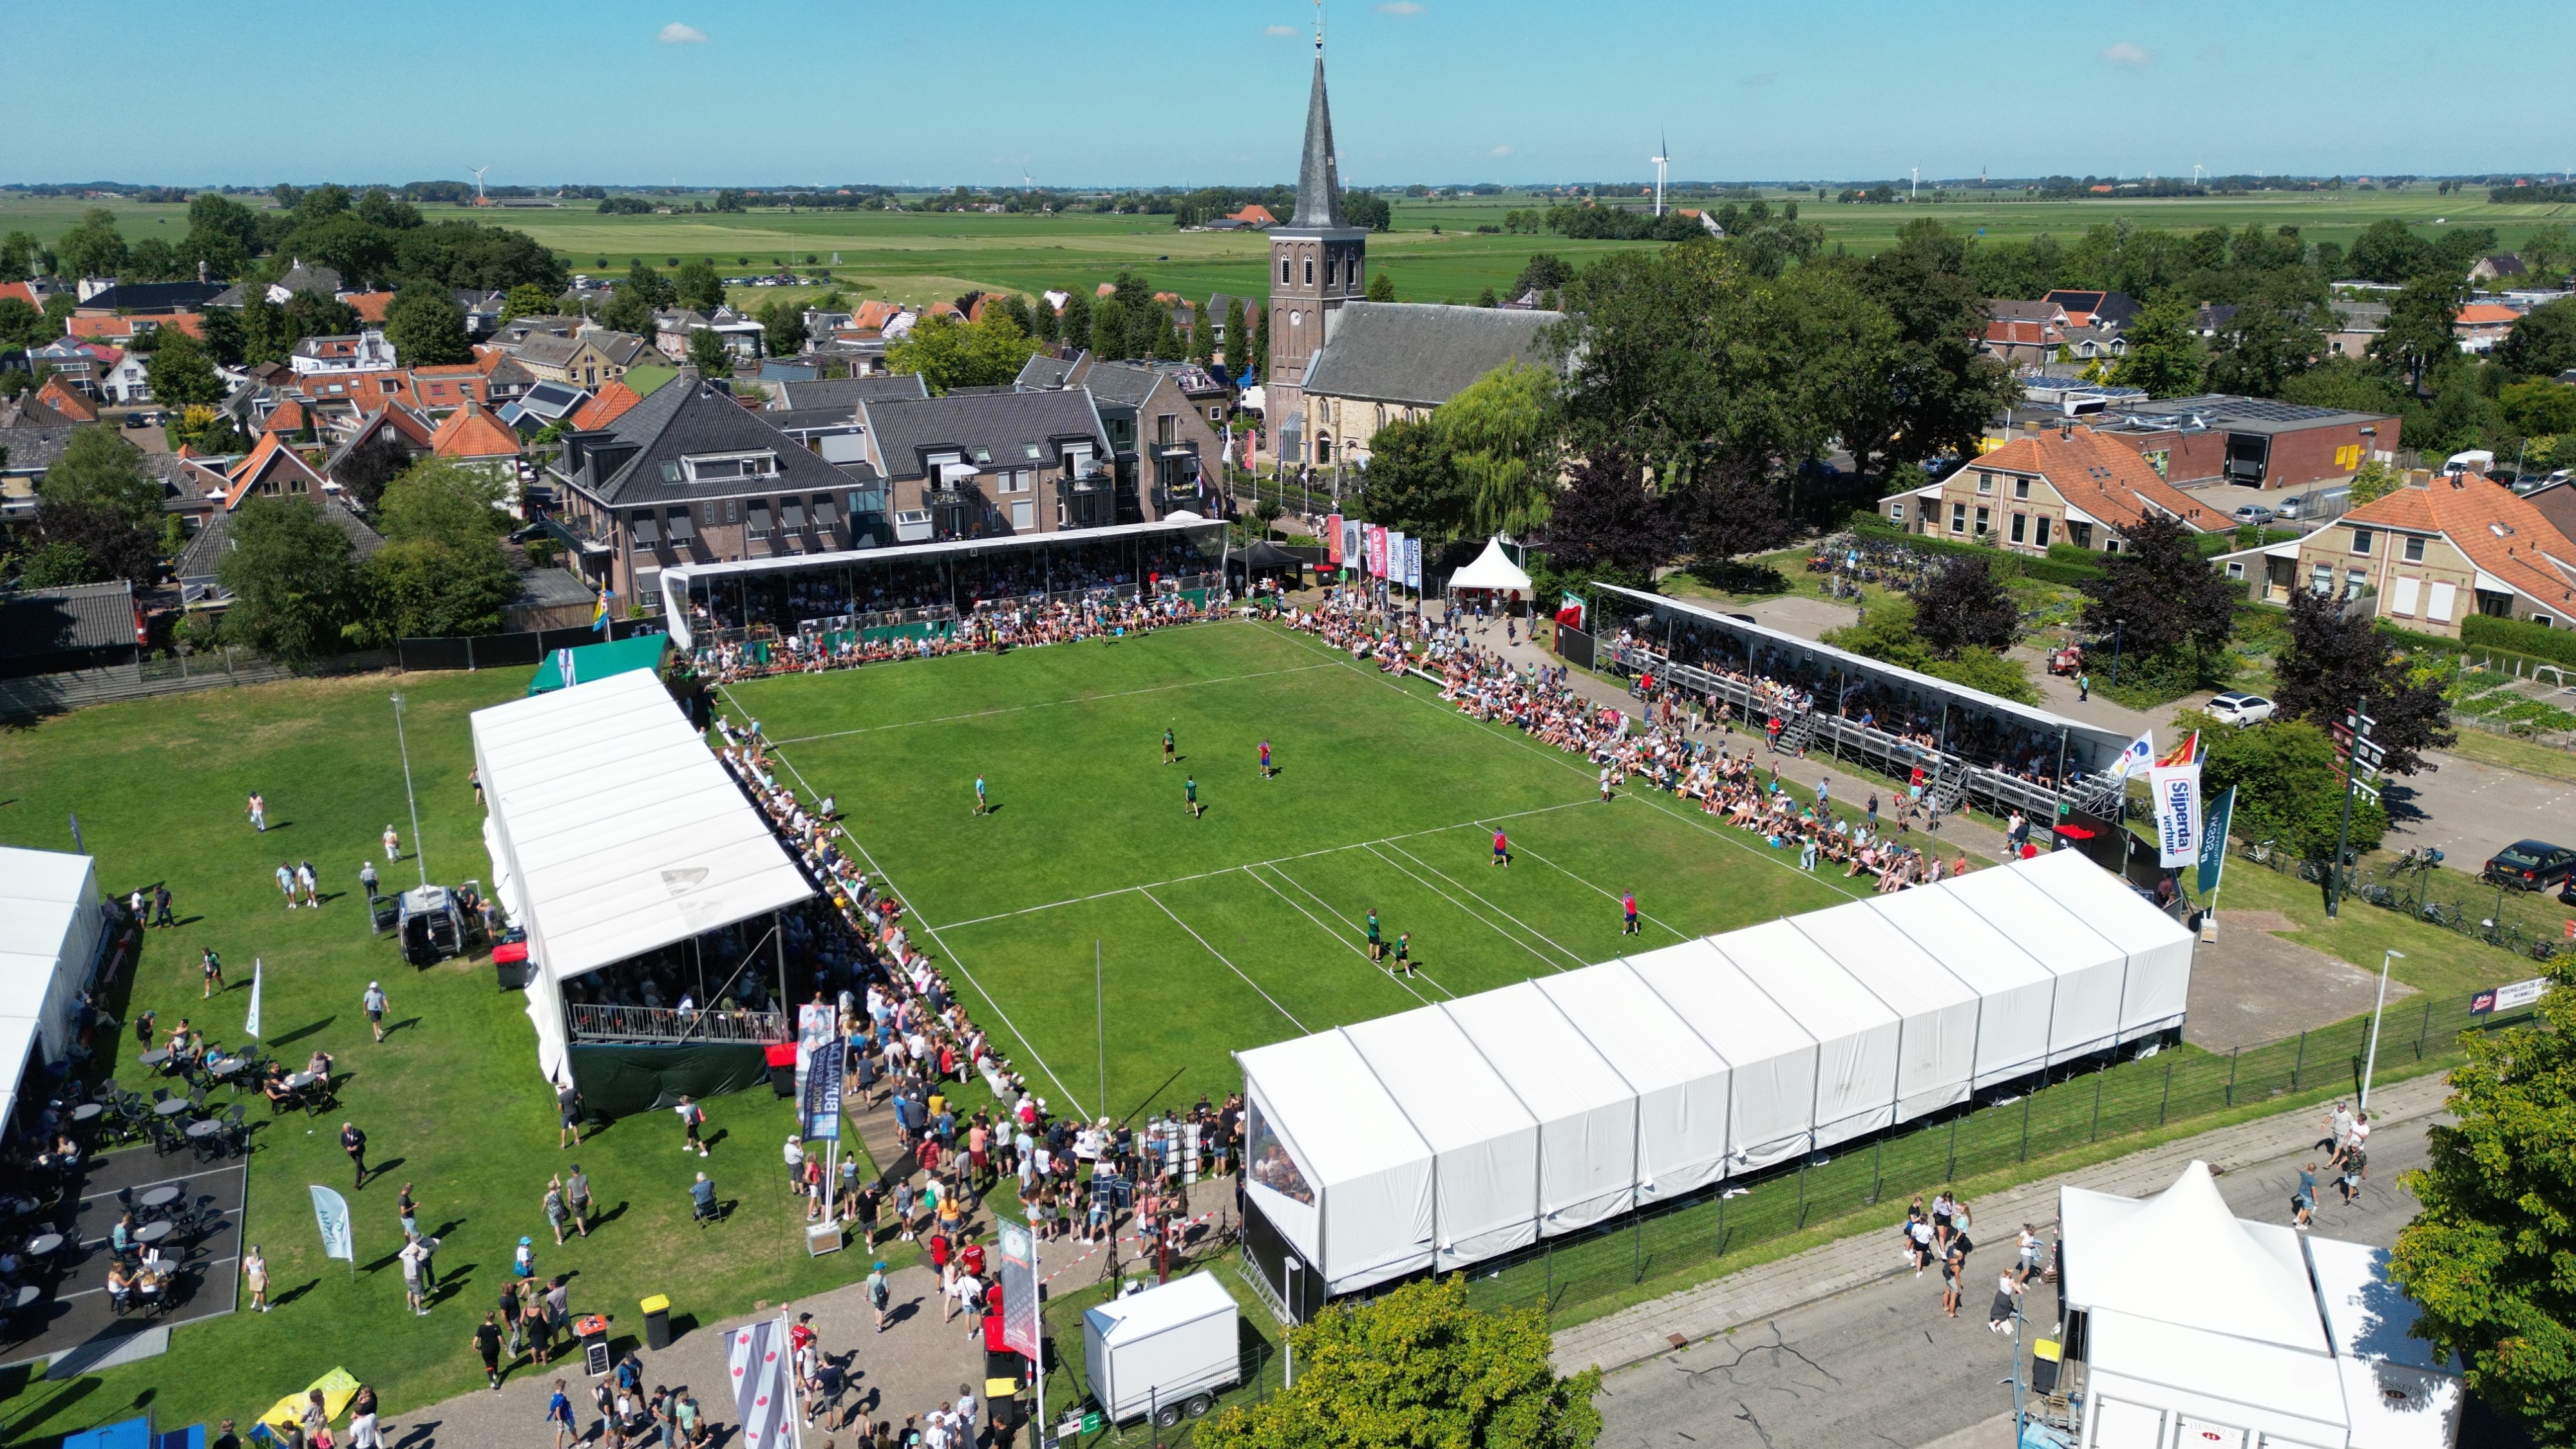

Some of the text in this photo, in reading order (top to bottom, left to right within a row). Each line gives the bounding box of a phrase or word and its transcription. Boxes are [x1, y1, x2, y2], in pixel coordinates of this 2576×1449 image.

[1806, 650, 1812, 659] D
[2170, 782, 2190, 848] Sijperda
[2163, 815, 2175, 856] verhuur
[2498, 984, 2528, 996] TWEEWIELERS
[2514, 990, 2535, 998] WOMMELS
[1059, 1425, 1072, 1434] WC
[2189, 1421, 2237, 1439] HESSEL'S
